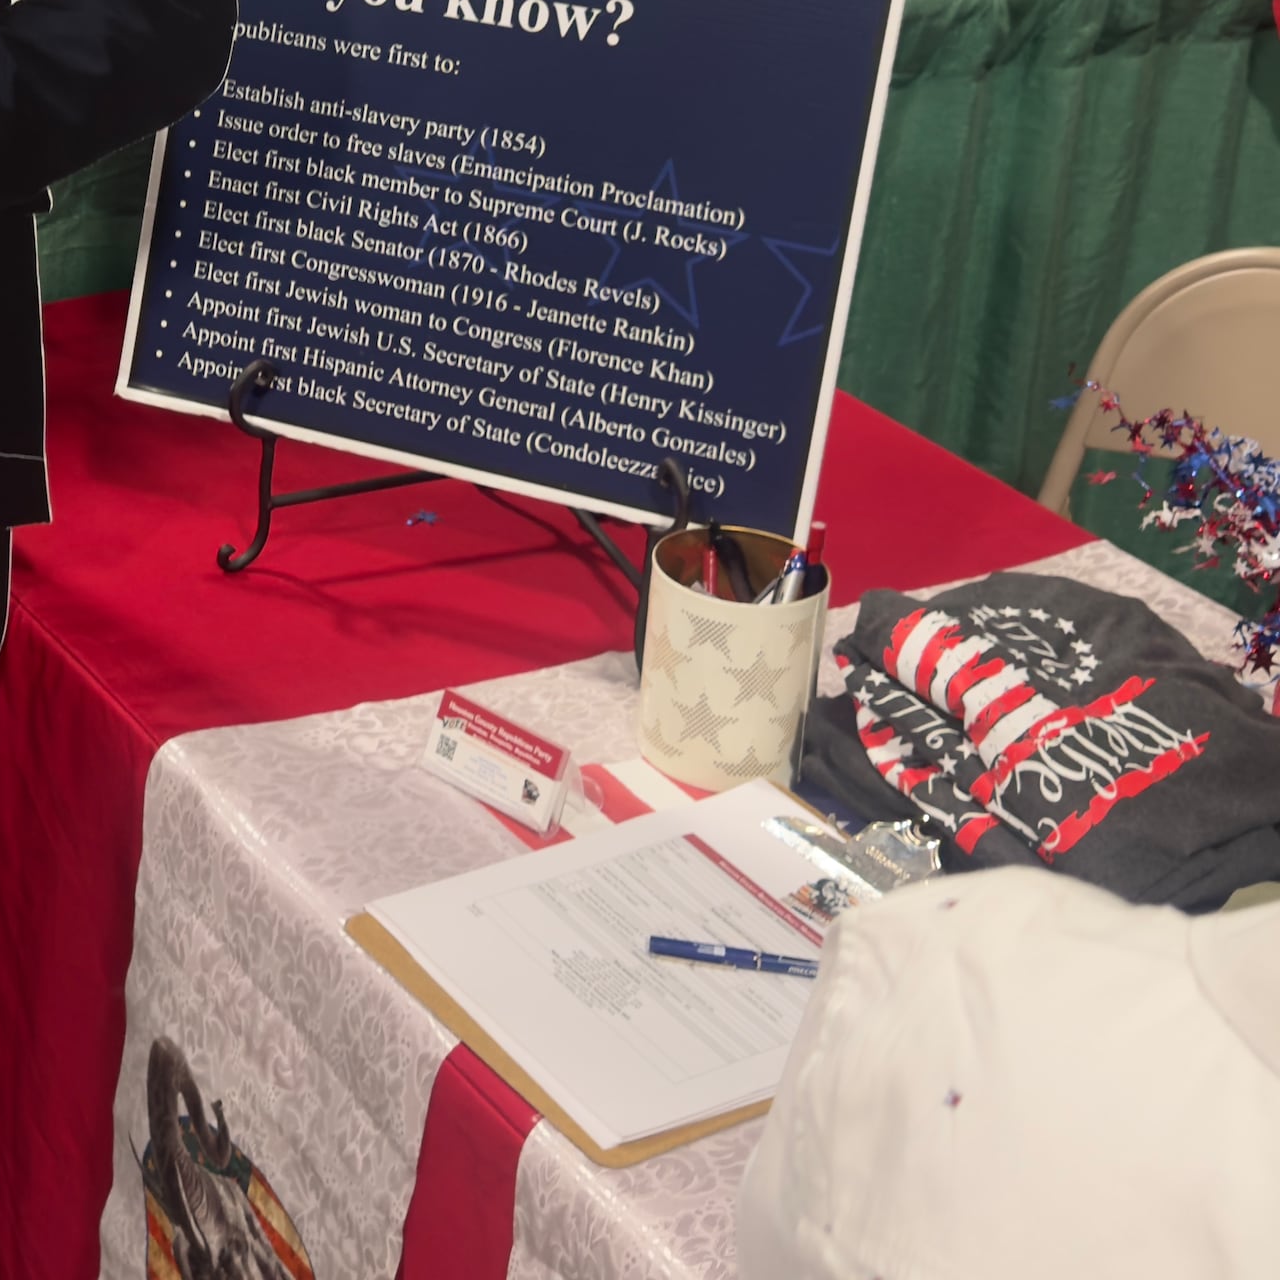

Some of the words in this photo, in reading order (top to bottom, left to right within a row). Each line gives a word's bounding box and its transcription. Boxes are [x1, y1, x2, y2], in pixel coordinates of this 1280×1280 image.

[232, 20, 328, 52] publicans
[333, 39, 382, 61] were
[387, 43, 428, 70] first
[434, 54, 461, 75] to:
[217, 109, 264, 135] Issue
[268, 123, 319, 145] order
[322, 131, 341, 149] to
[346, 133, 383, 158] free
[387, 142, 446, 170] slaves
[451, 154, 594, 199] (Emancipation
[600, 181, 745, 231] Proclamation)
[222, 79, 305, 112] Establish
[309, 99, 421, 137] anti-slavery
[424, 120, 476, 147] party
[480, 127, 546, 159] (1854)
[203, 200, 249, 226] Elect
[255, 210, 291, 235] first
[296, 217, 345, 247] black
[351, 230, 424, 262] Senator
[428, 247, 485, 274] (1870
[503, 261, 577, 294] Rhodes
[583, 277, 661, 315] Revels)
[208, 169, 258, 197] Enact
[265, 181, 300, 205] first
[306, 190, 353, 216] Civil
[358, 199, 419, 229] Rights
[422, 212, 460, 238] Act
[462, 222, 529, 255] (1866)
[213, 139, 258, 165] Elect
[264, 149, 301, 173] first
[306, 156, 356, 185] black
[361, 172, 440, 201] member
[444, 187, 463, 205] to
[468, 189, 555, 224] Supreme
[560, 207, 618, 236] Court
[622, 221, 646, 243] (J.
[654, 225, 727, 261] Rocks)
[193, 260, 239, 287] Elect
[245, 271, 281, 296] first
[285, 280, 348, 311] Jewish
[354, 298, 423, 327] woman
[428, 312, 448, 332] to
[452, 316, 543, 353] Congress
[547, 337, 644, 376] (Florence
[649, 358, 714, 394] Khan)
[198, 230, 244, 257] Elect
[249, 240, 286, 265] first
[291, 249, 446, 299] Congresswoman
[451, 284, 508, 312] (1916
[526, 299, 608, 334] Jeanette
[612, 317, 695, 356] Rankin)
[177, 351, 244, 382] Appoin
[297, 376, 347, 407] black
[352, 389, 443, 432] Secretary
[446, 414, 472, 434] of
[473, 418, 523, 448] State
[687, 467, 726, 499] ice)
[182, 321, 255, 353] Appoint
[261, 337, 297, 363] first
[302, 346, 385, 382] Hispanic
[388, 367, 474, 406] Attorney
[478, 387, 556, 422] General
[560, 406, 646, 443] (Alberto
[651, 427, 756, 472] Gonzales)
[187, 291, 260, 323] Appoint
[266, 307, 303, 332] first
[306, 316, 370, 347] Jewish
[376, 330, 416, 358] U.S.
[422, 341, 514, 383] Secretary
[518, 366, 545, 385] of
[545, 369, 596, 398] State
[600, 382, 673, 419] (Henry
[678, 398, 787, 444] Kissinger)
[874, 688, 961, 750] 1776
